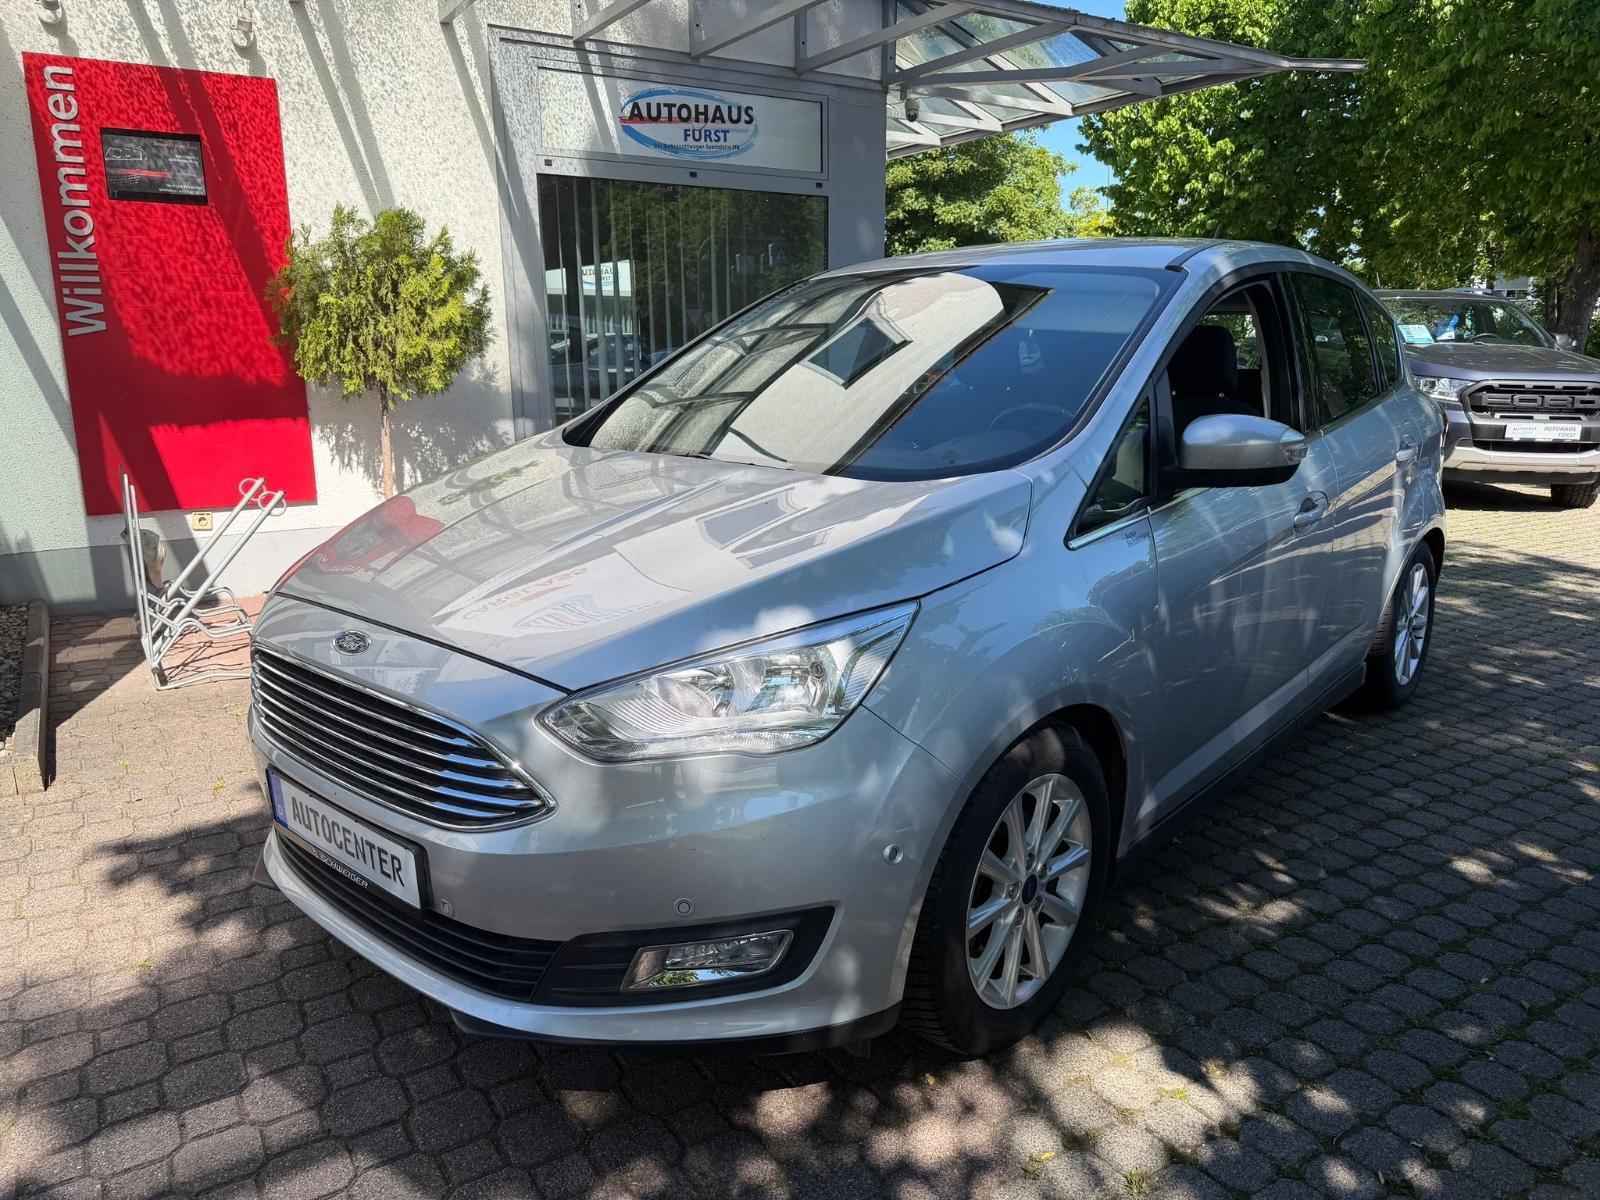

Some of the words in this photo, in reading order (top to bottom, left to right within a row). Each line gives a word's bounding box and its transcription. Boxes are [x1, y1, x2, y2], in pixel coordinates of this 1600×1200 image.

[629, 102, 754, 125] AUTOHAUS
[43, 65, 108, 337] Willkommen
[1482, 392, 1600, 409] FORD
[291, 796, 406, 888] AUTOCENTER
[320, 854, 369, 889] SCHWEIGER
